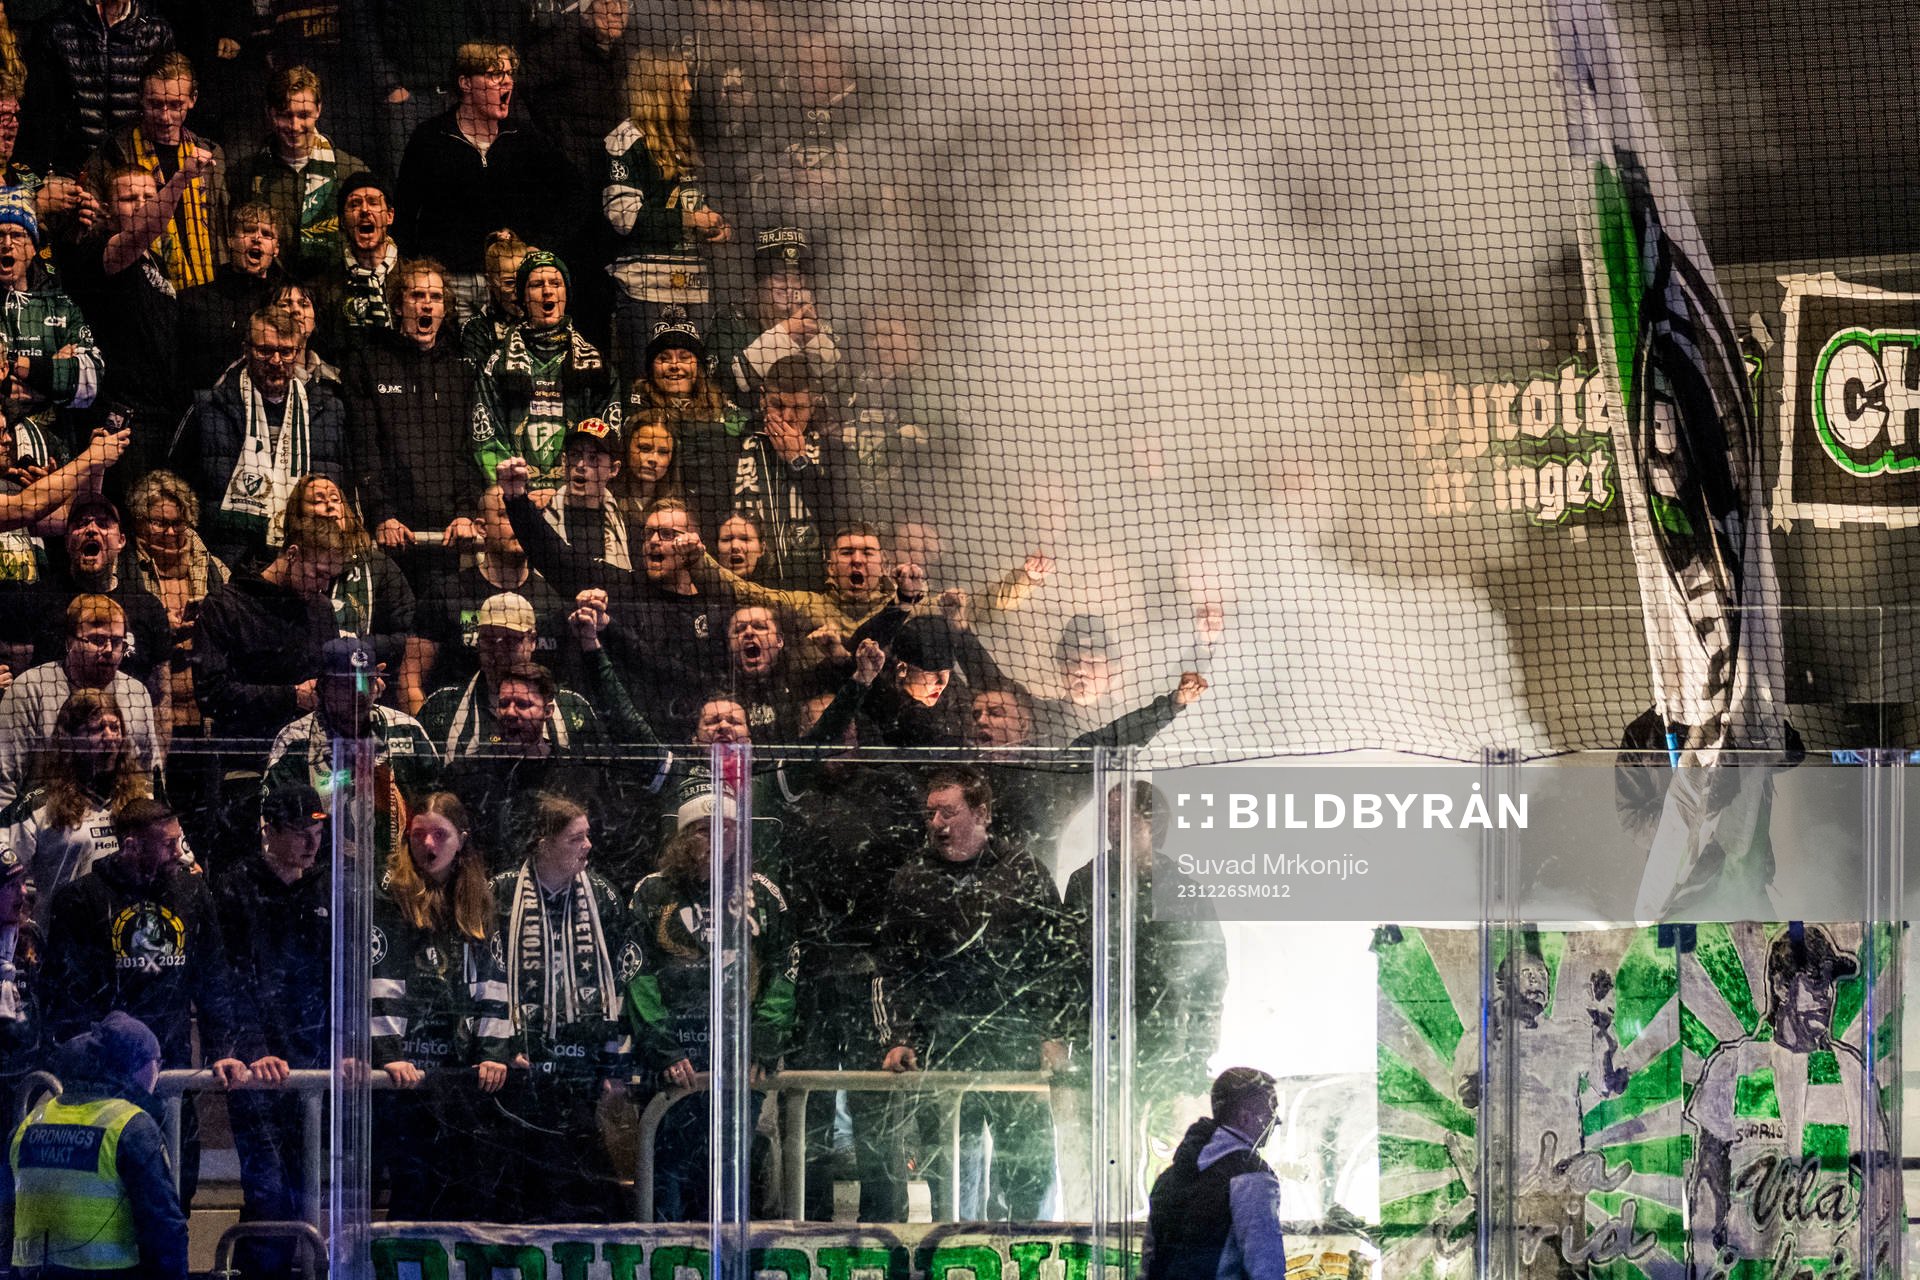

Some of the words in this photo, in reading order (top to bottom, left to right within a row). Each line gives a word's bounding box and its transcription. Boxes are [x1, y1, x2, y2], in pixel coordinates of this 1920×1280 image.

[1494, 450, 1609, 520] inget
[115, 955, 145, 969] 2013
[159, 954, 186, 967] 2023
[29, 1128, 96, 1149] ORDNINGS
[40, 1146, 74, 1164] VAKT
